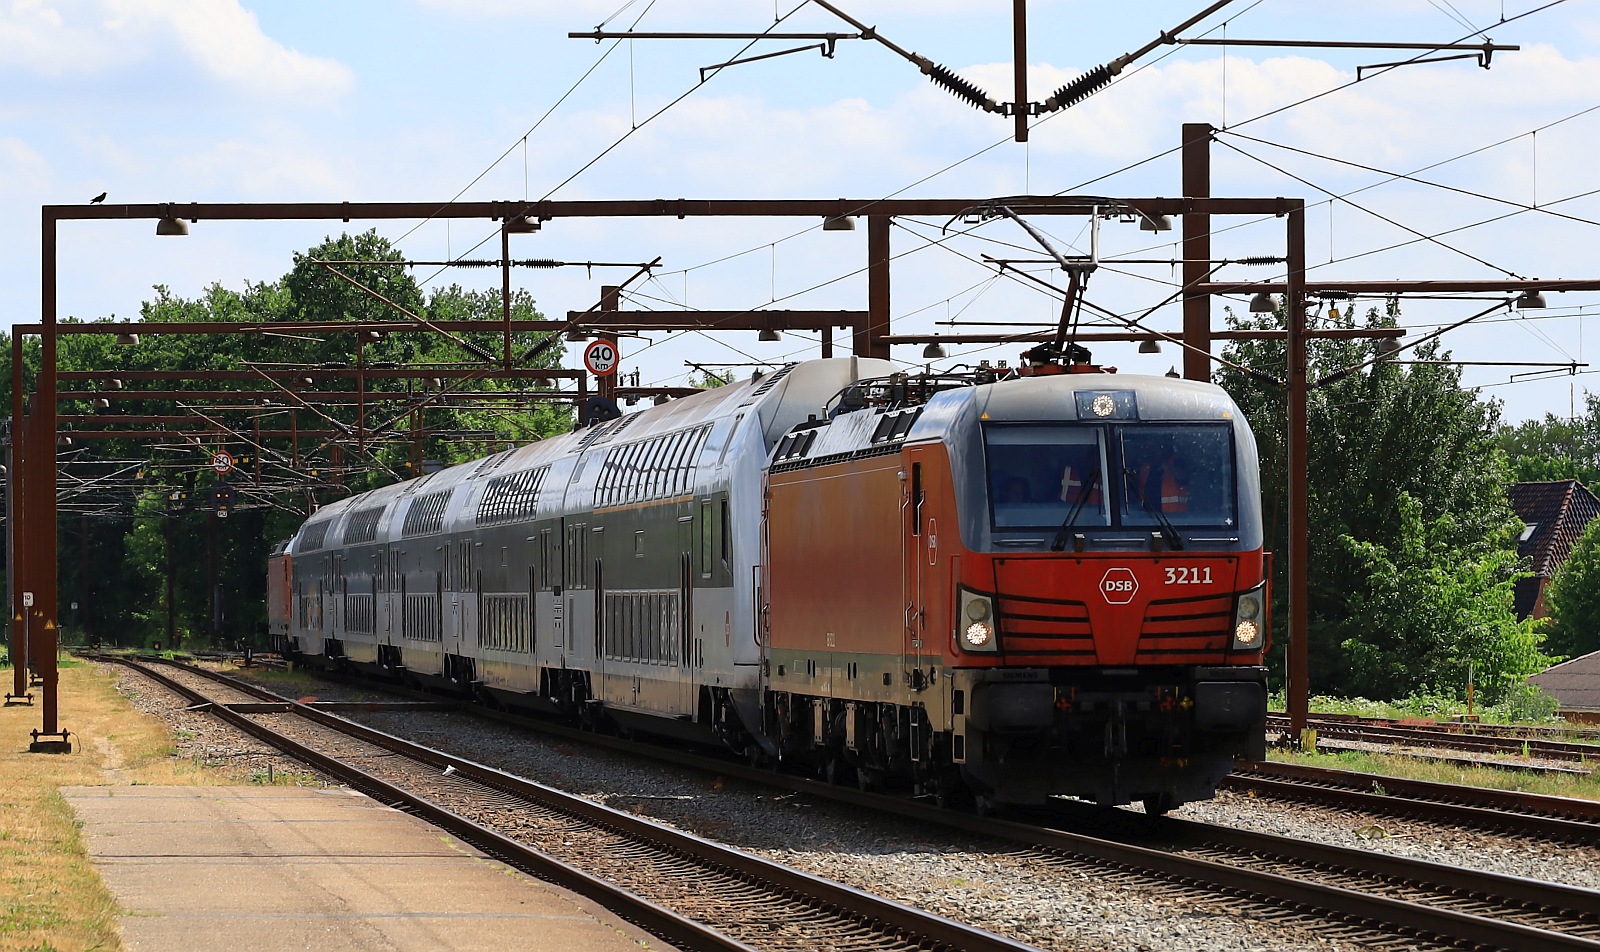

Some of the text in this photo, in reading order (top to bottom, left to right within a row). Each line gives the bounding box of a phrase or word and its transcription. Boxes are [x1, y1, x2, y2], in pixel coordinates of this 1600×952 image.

[589, 346, 613, 361] 40
[595, 362, 609, 370] km
[1164, 567, 1213, 585] 3211
[1105, 580, 1133, 592] DSB
